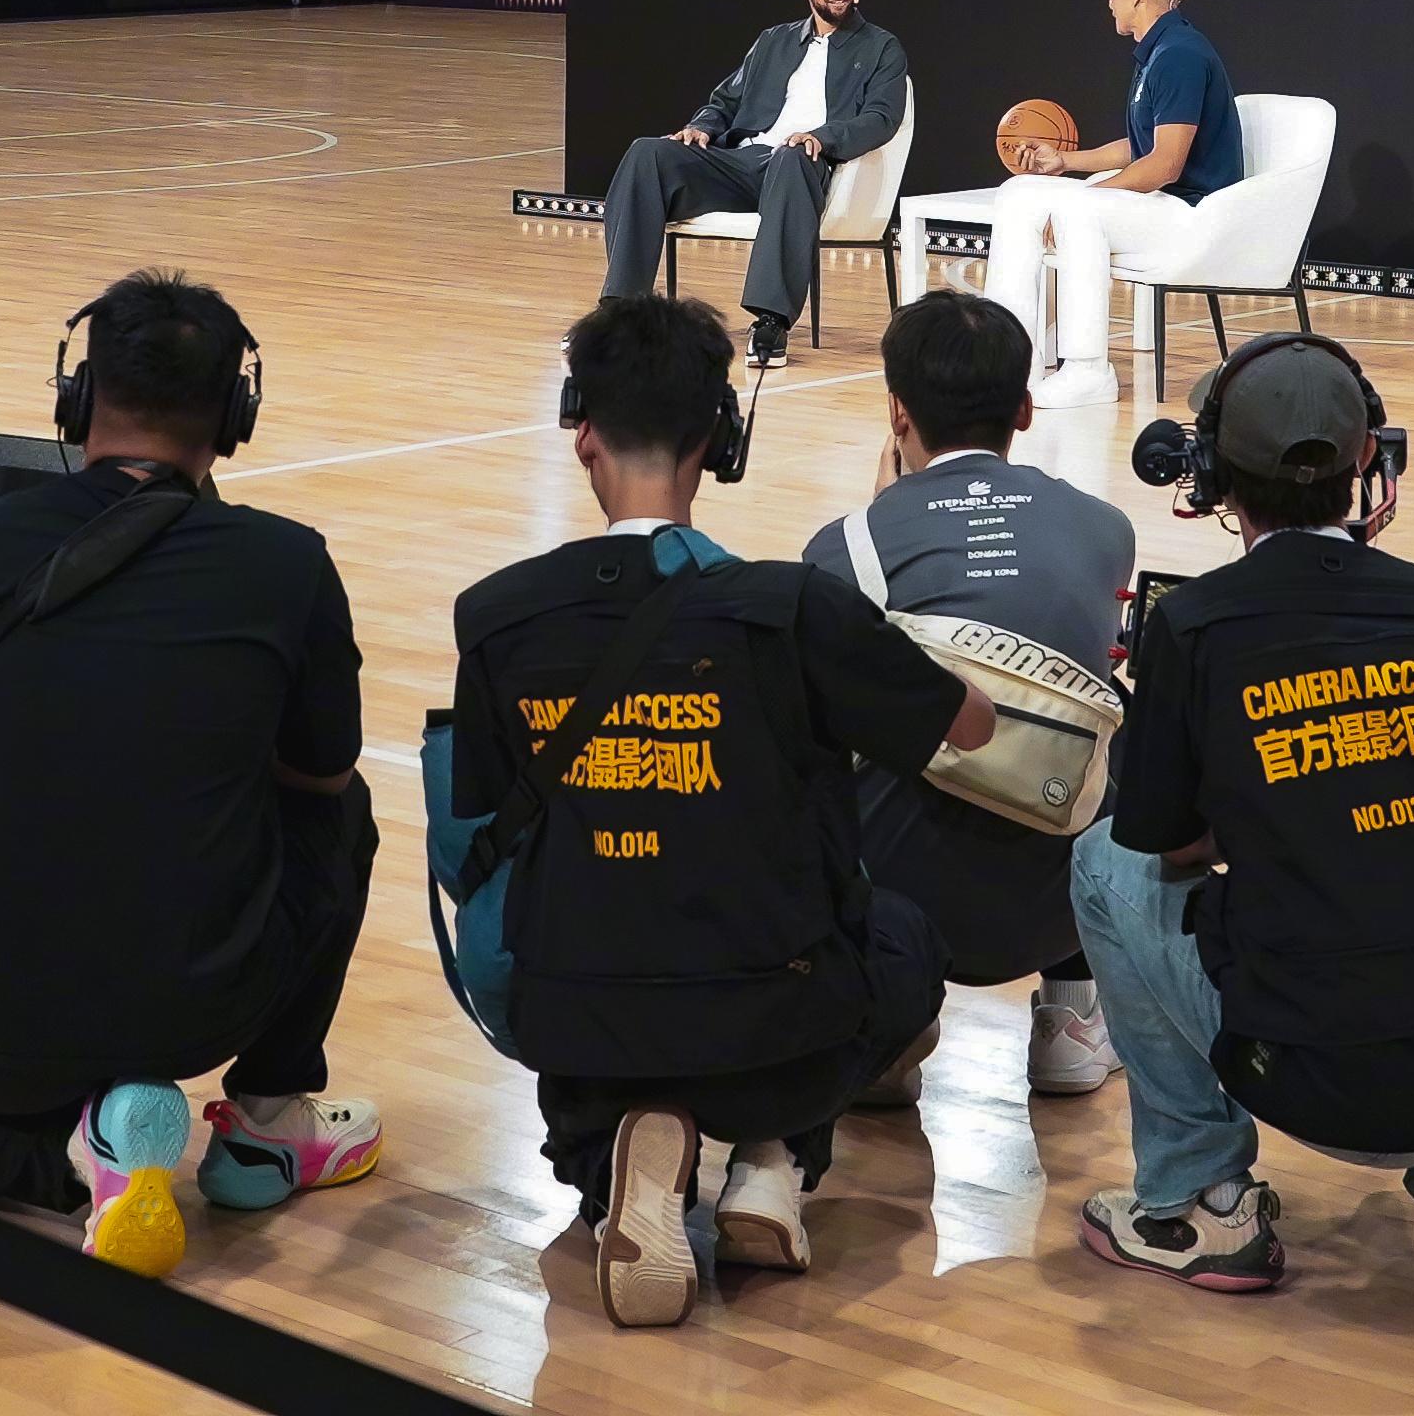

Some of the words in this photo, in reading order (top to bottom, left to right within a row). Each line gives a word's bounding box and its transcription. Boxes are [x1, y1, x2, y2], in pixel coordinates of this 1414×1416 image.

[927, 496, 988, 510] STEPHEN
[991, 494, 1033, 504] CURRY
[967, 549, 1017, 560] DONGGUAN
[966, 569, 992, 578] HONG
[994, 568, 1019, 577] KONG
[1243, 667, 1363, 721] CAMERA
[623, 692, 722, 731] ACCESS
[594, 830, 659, 858] NO.014
